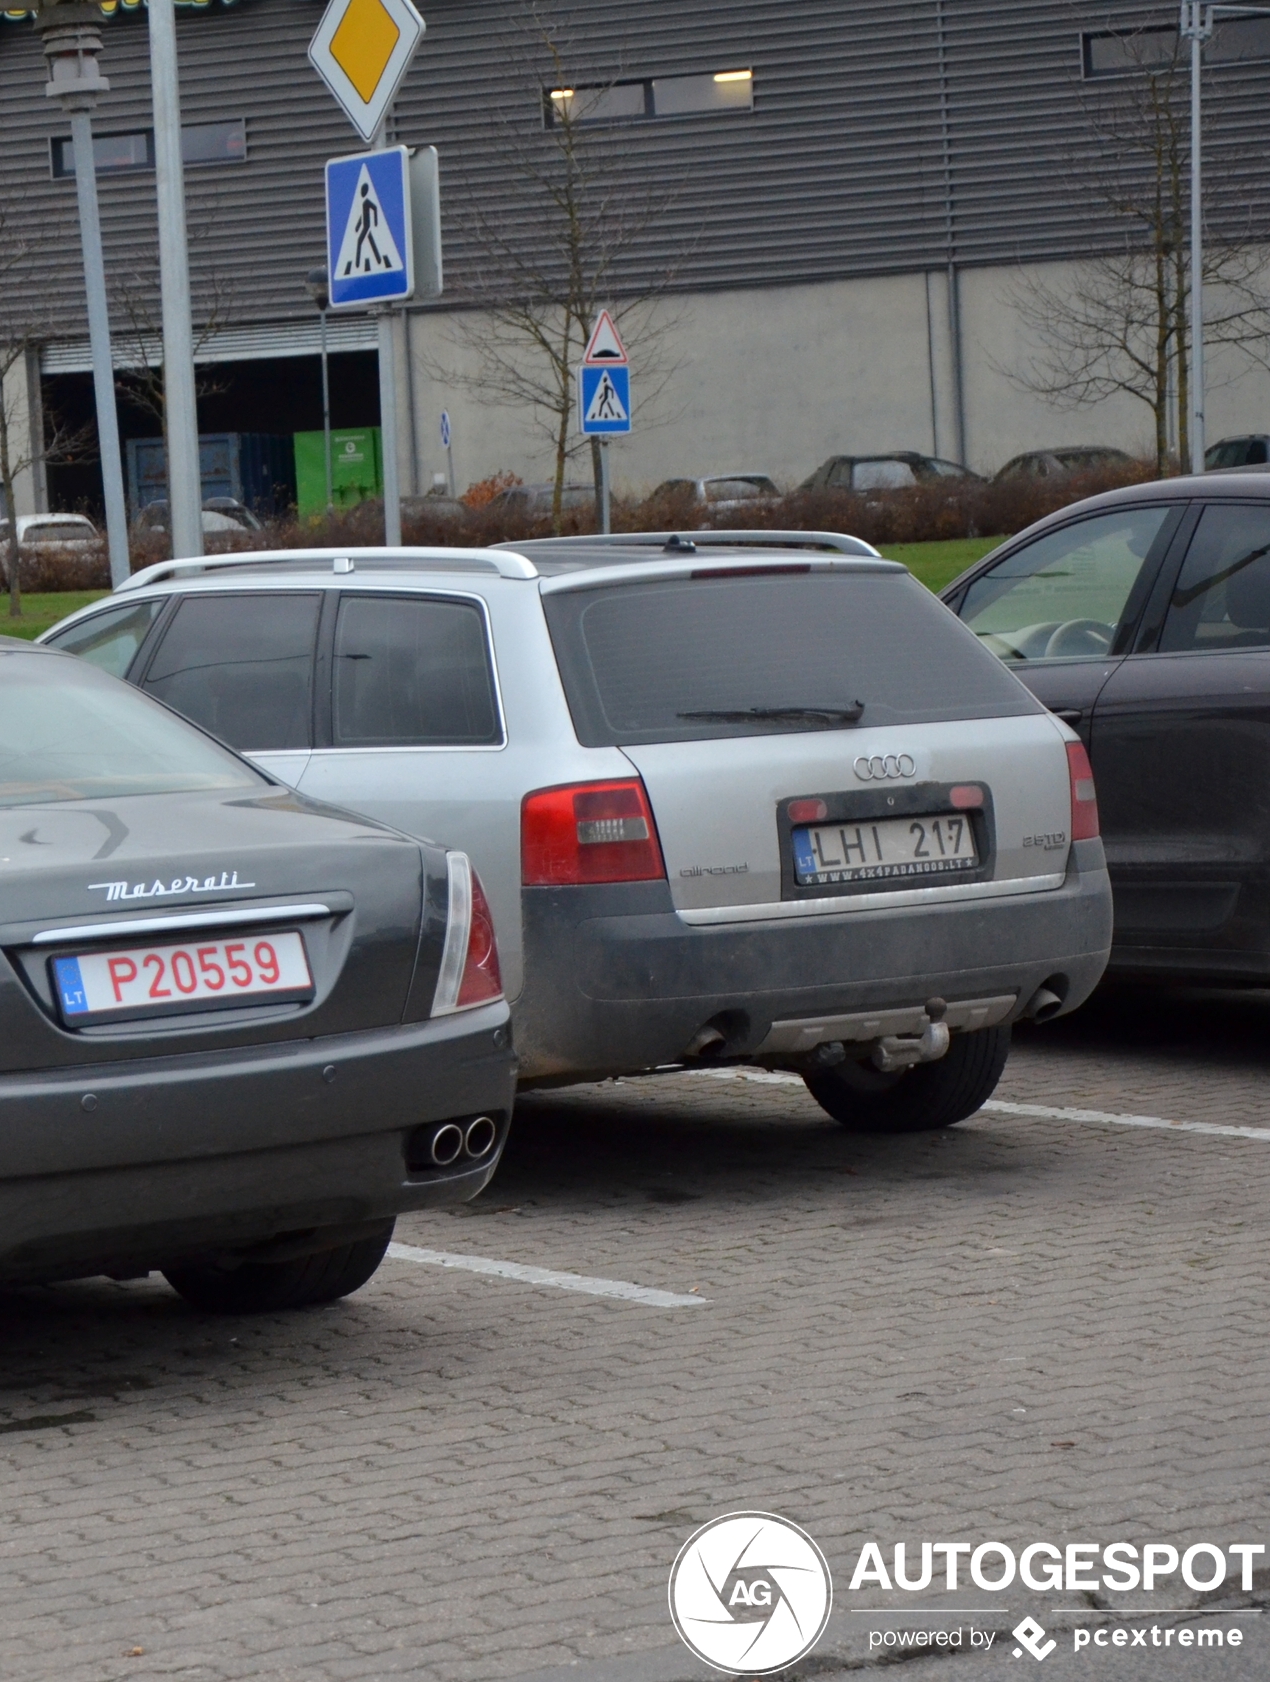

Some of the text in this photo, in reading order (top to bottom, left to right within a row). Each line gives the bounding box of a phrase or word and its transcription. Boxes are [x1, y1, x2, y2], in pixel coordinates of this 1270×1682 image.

[815, 818, 963, 867] LHI 217
[679, 861, 749, 878] allroad
[798, 856, 813, 867] LT
[87, 871, 256, 901] Maserati
[107, 941, 280, 1003] P20559
[64, 991, 83, 1006] LT
